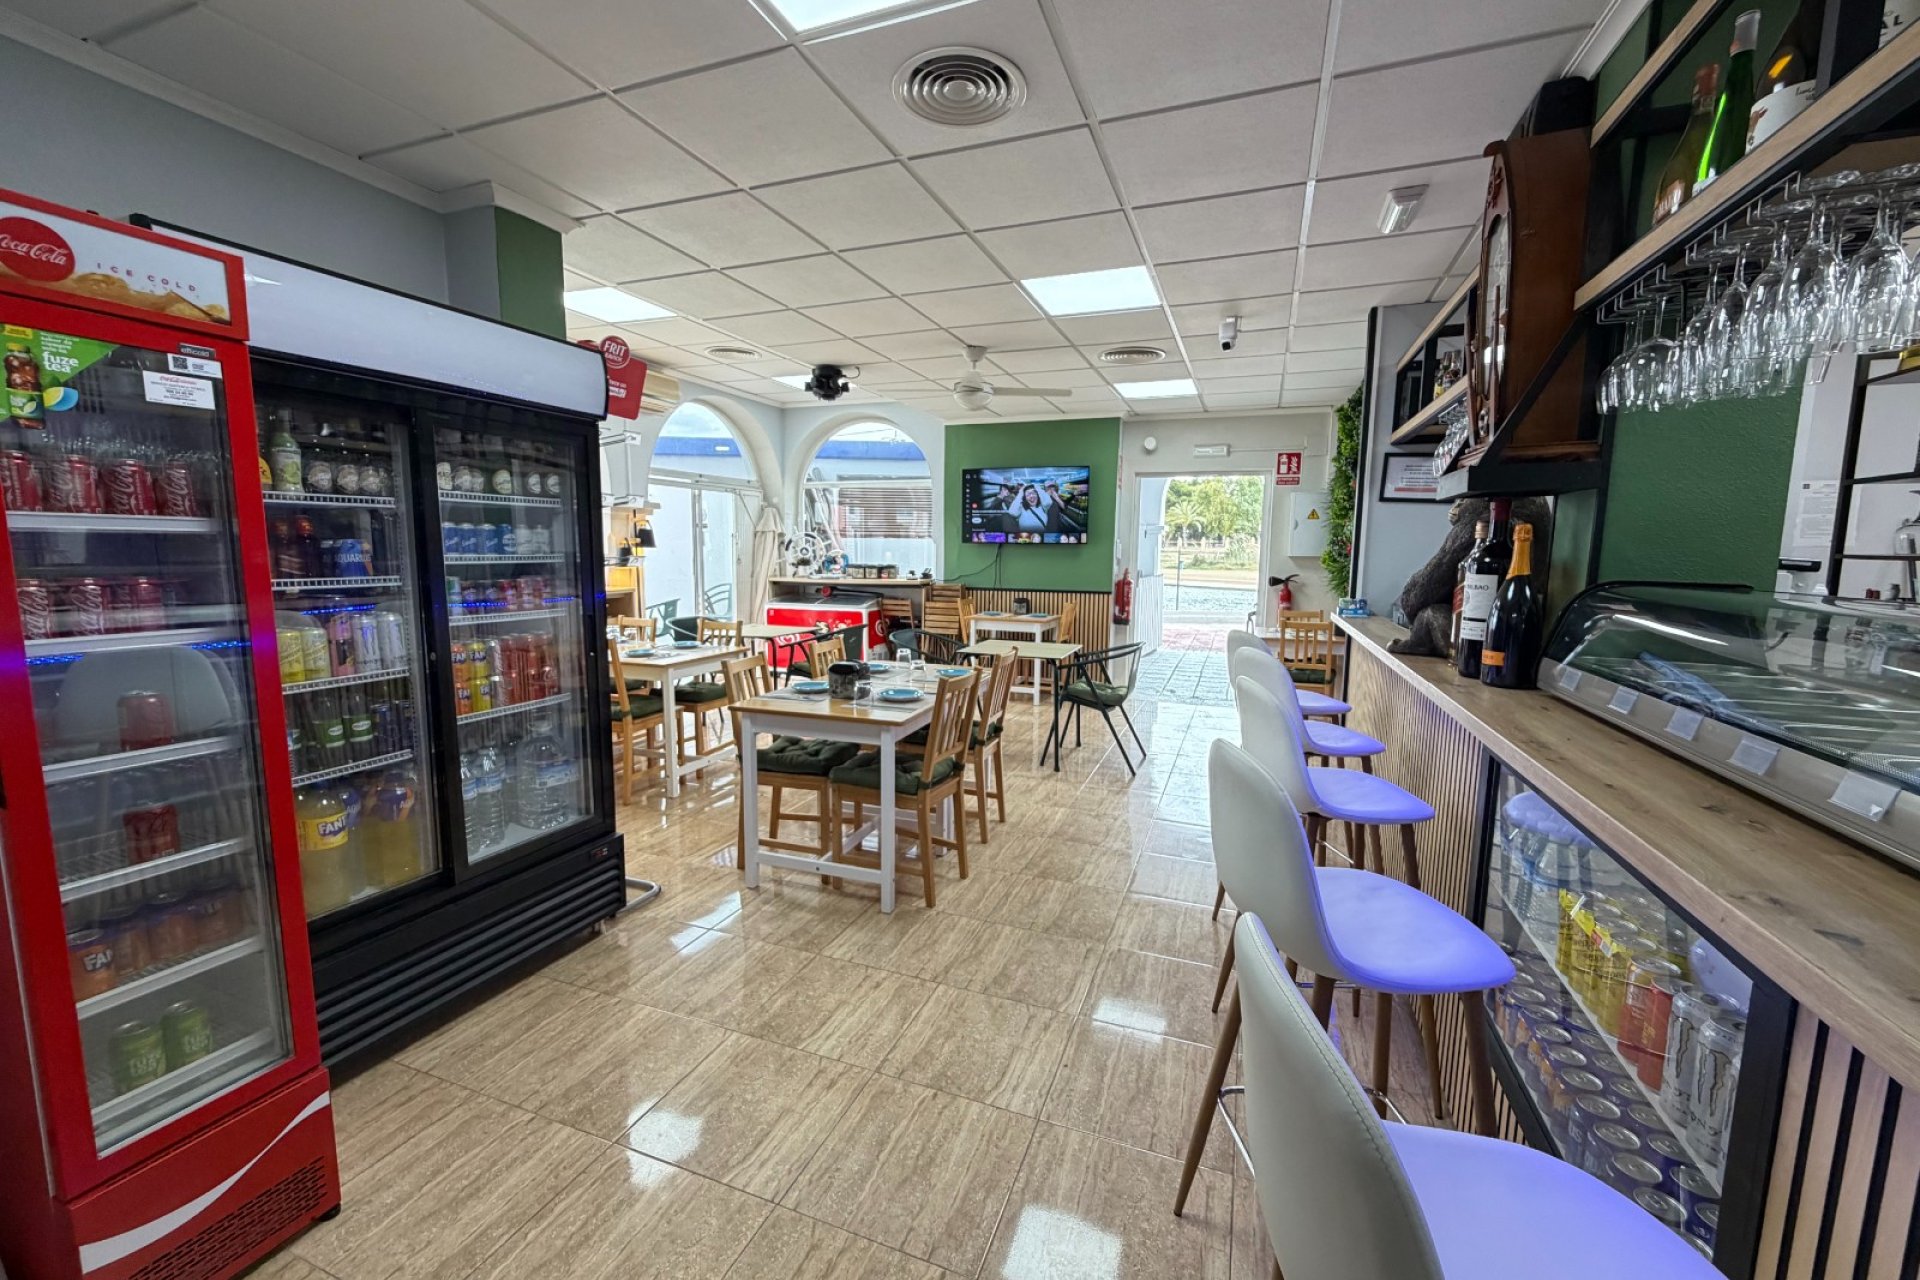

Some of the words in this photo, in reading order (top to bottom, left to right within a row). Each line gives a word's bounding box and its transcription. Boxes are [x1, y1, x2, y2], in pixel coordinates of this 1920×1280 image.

[97, 262, 133, 277] ICE
[147, 274, 196, 292] COLD
[603, 340, 627, 357] FRIT
[43, 351, 79, 367] fuze
[44, 362, 71, 373] tea
